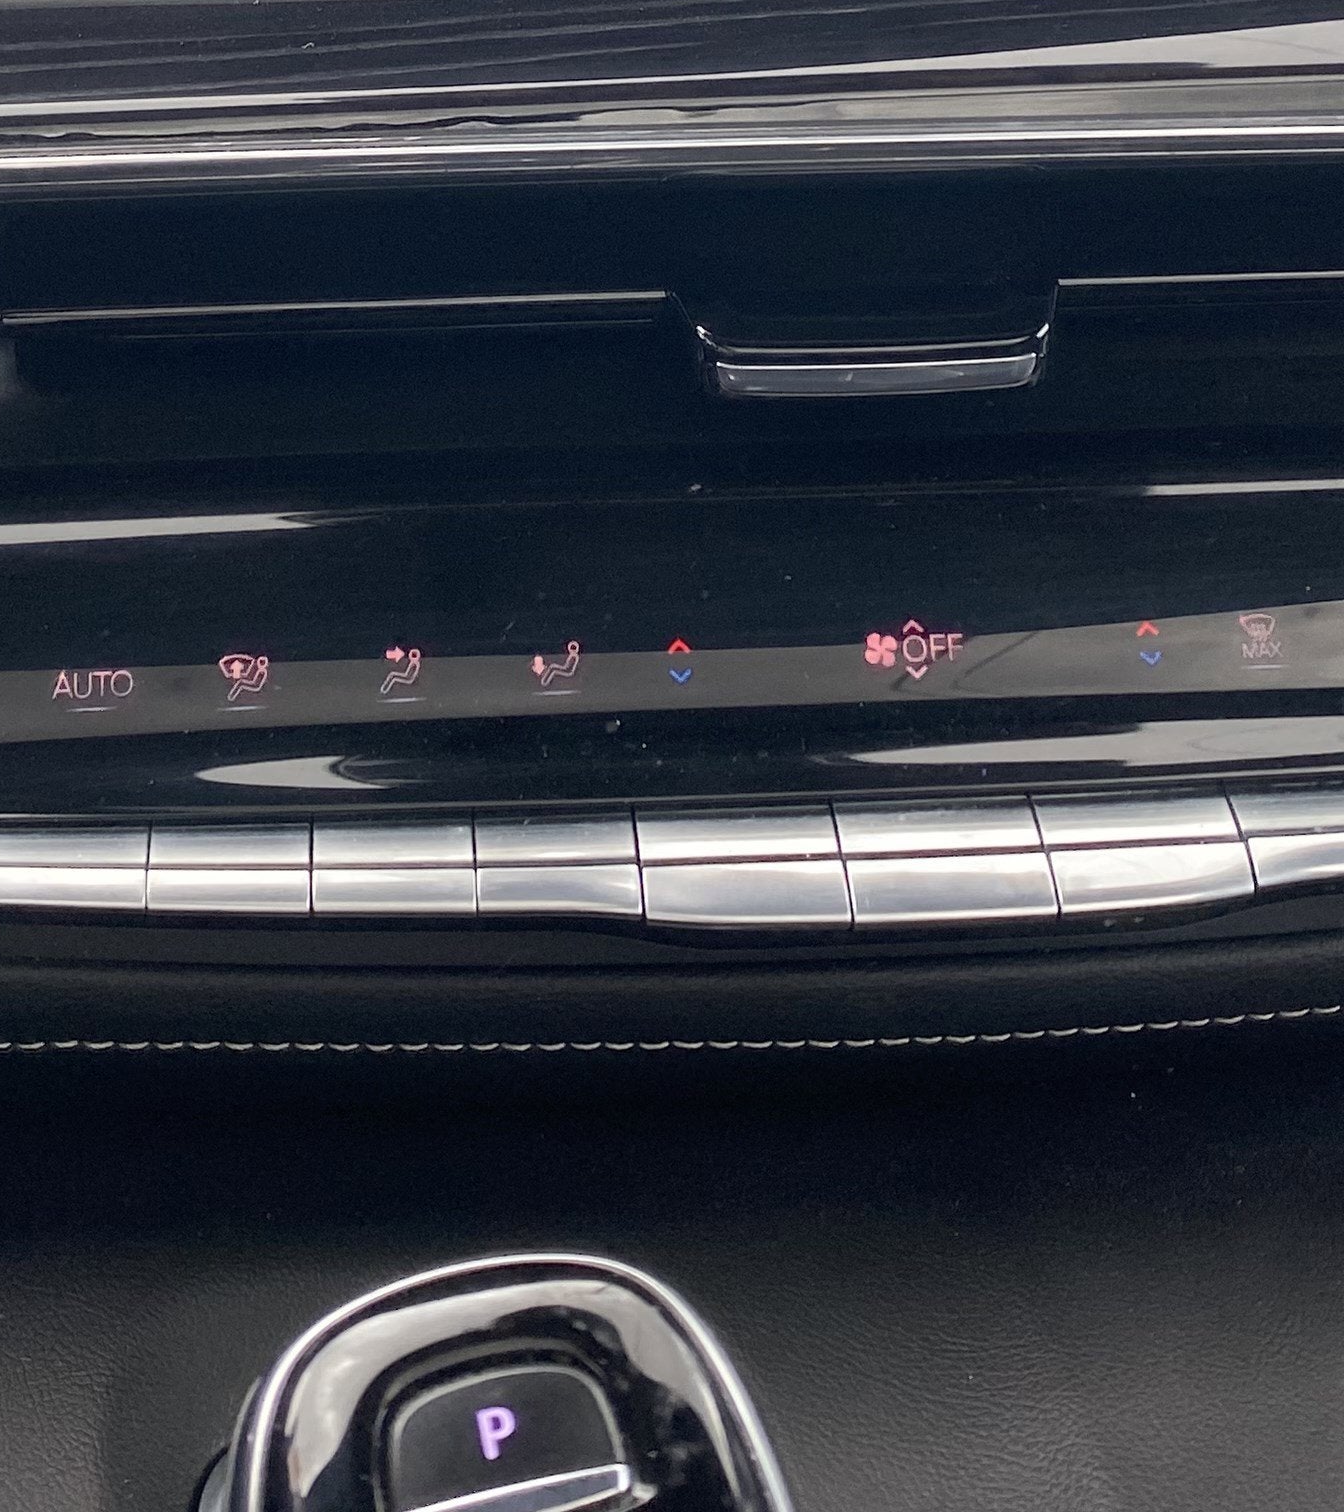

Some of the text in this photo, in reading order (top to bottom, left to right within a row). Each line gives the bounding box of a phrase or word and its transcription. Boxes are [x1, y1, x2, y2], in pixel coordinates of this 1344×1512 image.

[901, 632, 964, 664] OFF
[1241, 641, 1283, 659] MAX
[51, 670, 134, 700] AUTO
[475, 1405, 517, 1461] P
